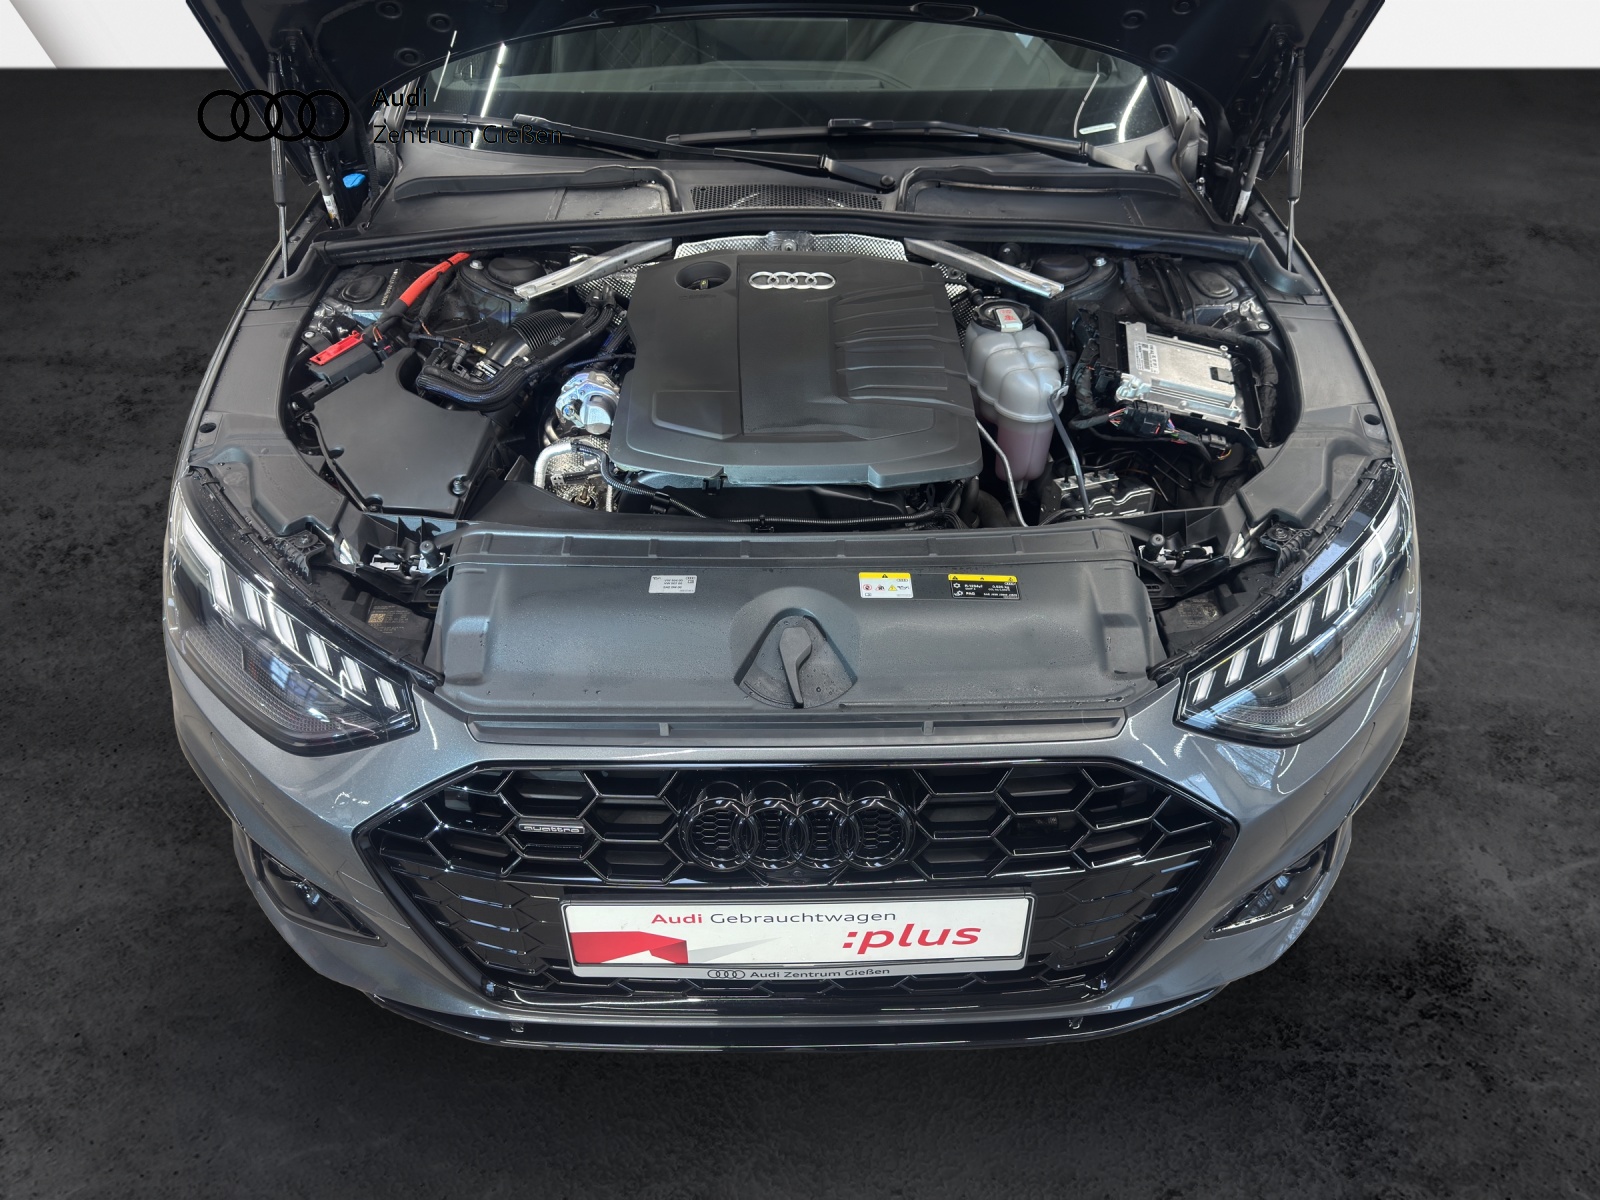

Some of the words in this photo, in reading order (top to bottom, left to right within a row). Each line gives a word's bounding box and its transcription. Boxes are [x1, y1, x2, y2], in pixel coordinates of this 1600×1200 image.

[651, 913, 703, 925] Audi
[709, 911, 897, 926] Gebrauchtwagen
[750, 971, 780, 979] Audi
[783, 970, 841, 979] Zentrum
[845, 968, 890, 977] Gießen
